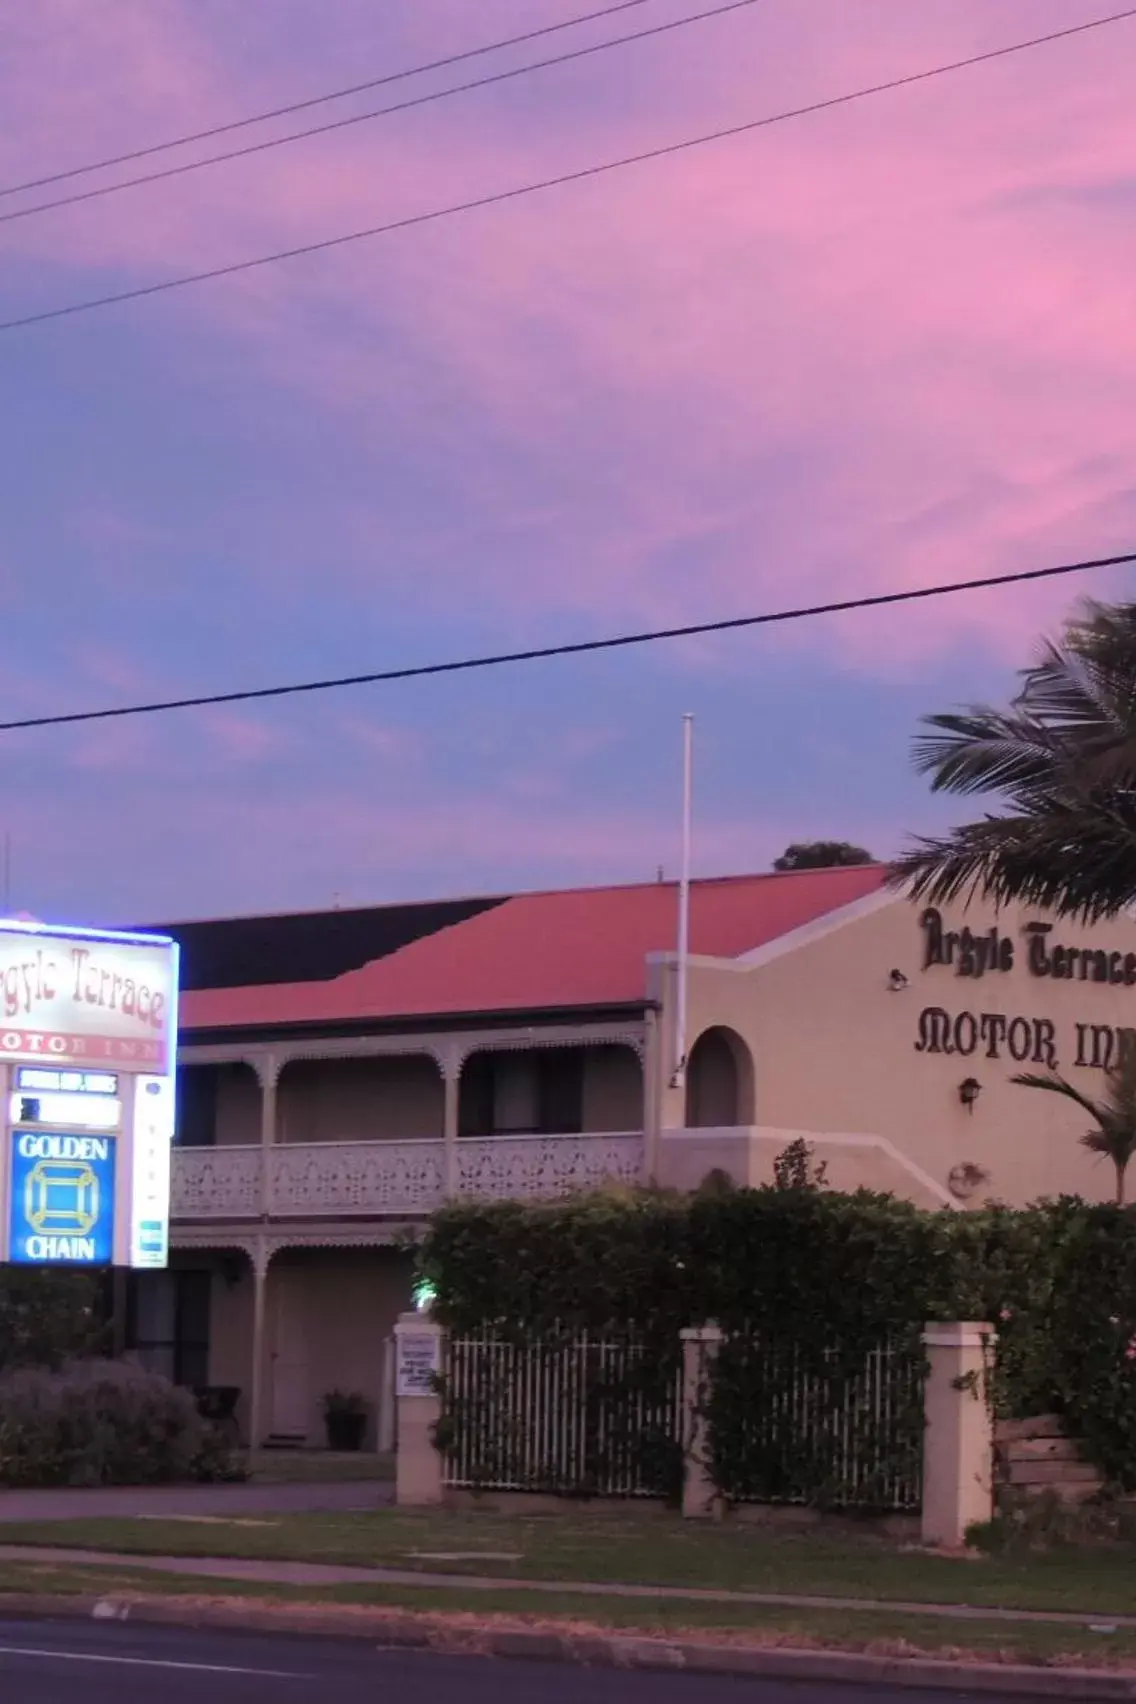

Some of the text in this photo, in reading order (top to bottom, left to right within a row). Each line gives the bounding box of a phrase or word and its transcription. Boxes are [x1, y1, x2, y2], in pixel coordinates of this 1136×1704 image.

[919, 907, 1014, 978] Argyle
[0, 948, 165, 1030] gyle Terrace
[0, 1031, 86, 1054] OTOR
[914, 1006, 1059, 1070] MOTOR
[18, 1134, 109, 1161] GOLDEN
[25, 1235, 95, 1260] CHAIN
